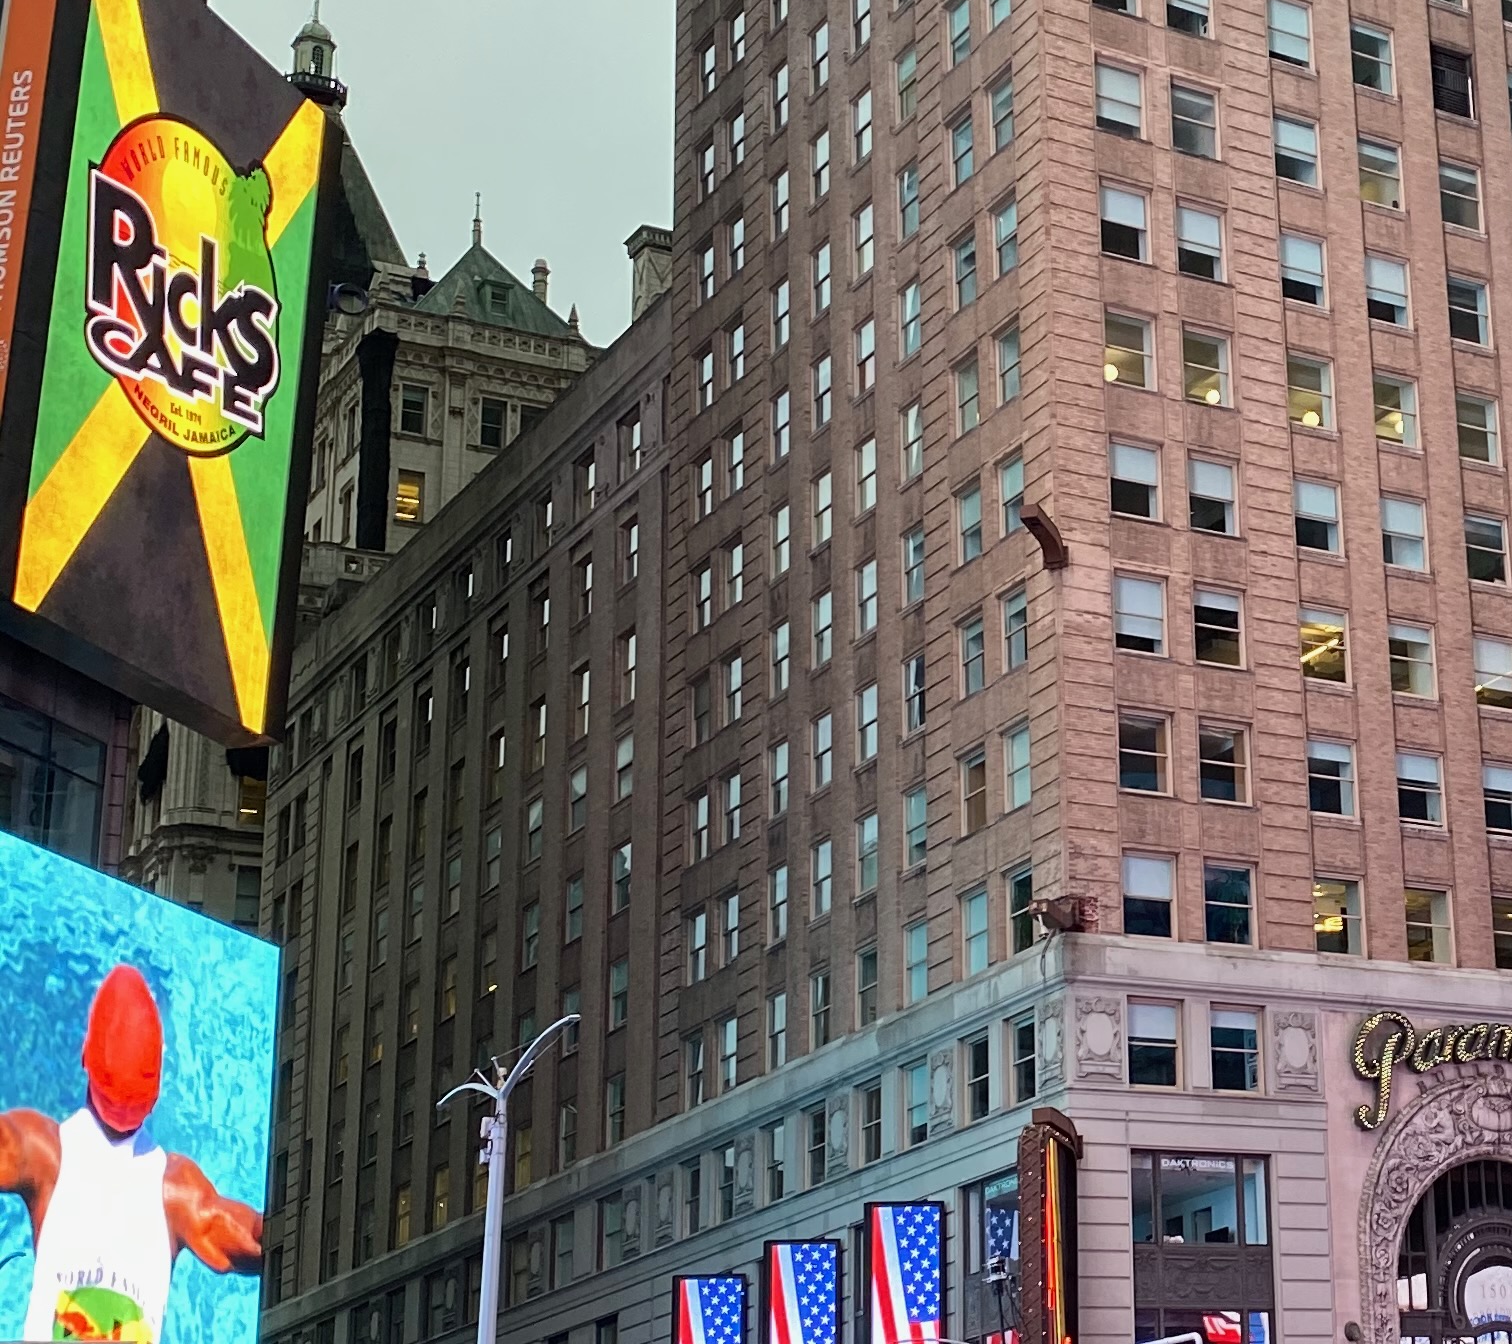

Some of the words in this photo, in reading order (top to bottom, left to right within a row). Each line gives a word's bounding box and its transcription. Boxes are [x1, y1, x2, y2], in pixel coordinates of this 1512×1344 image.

[0, 68, 33, 182] REUTERS
[120, 135, 165, 182] WORLD
[174, 137, 229, 197] FAMOUS
[182, 424, 238, 444] JAMAICA
[1161, 1158, 1234, 1169] DAKTRONICS
